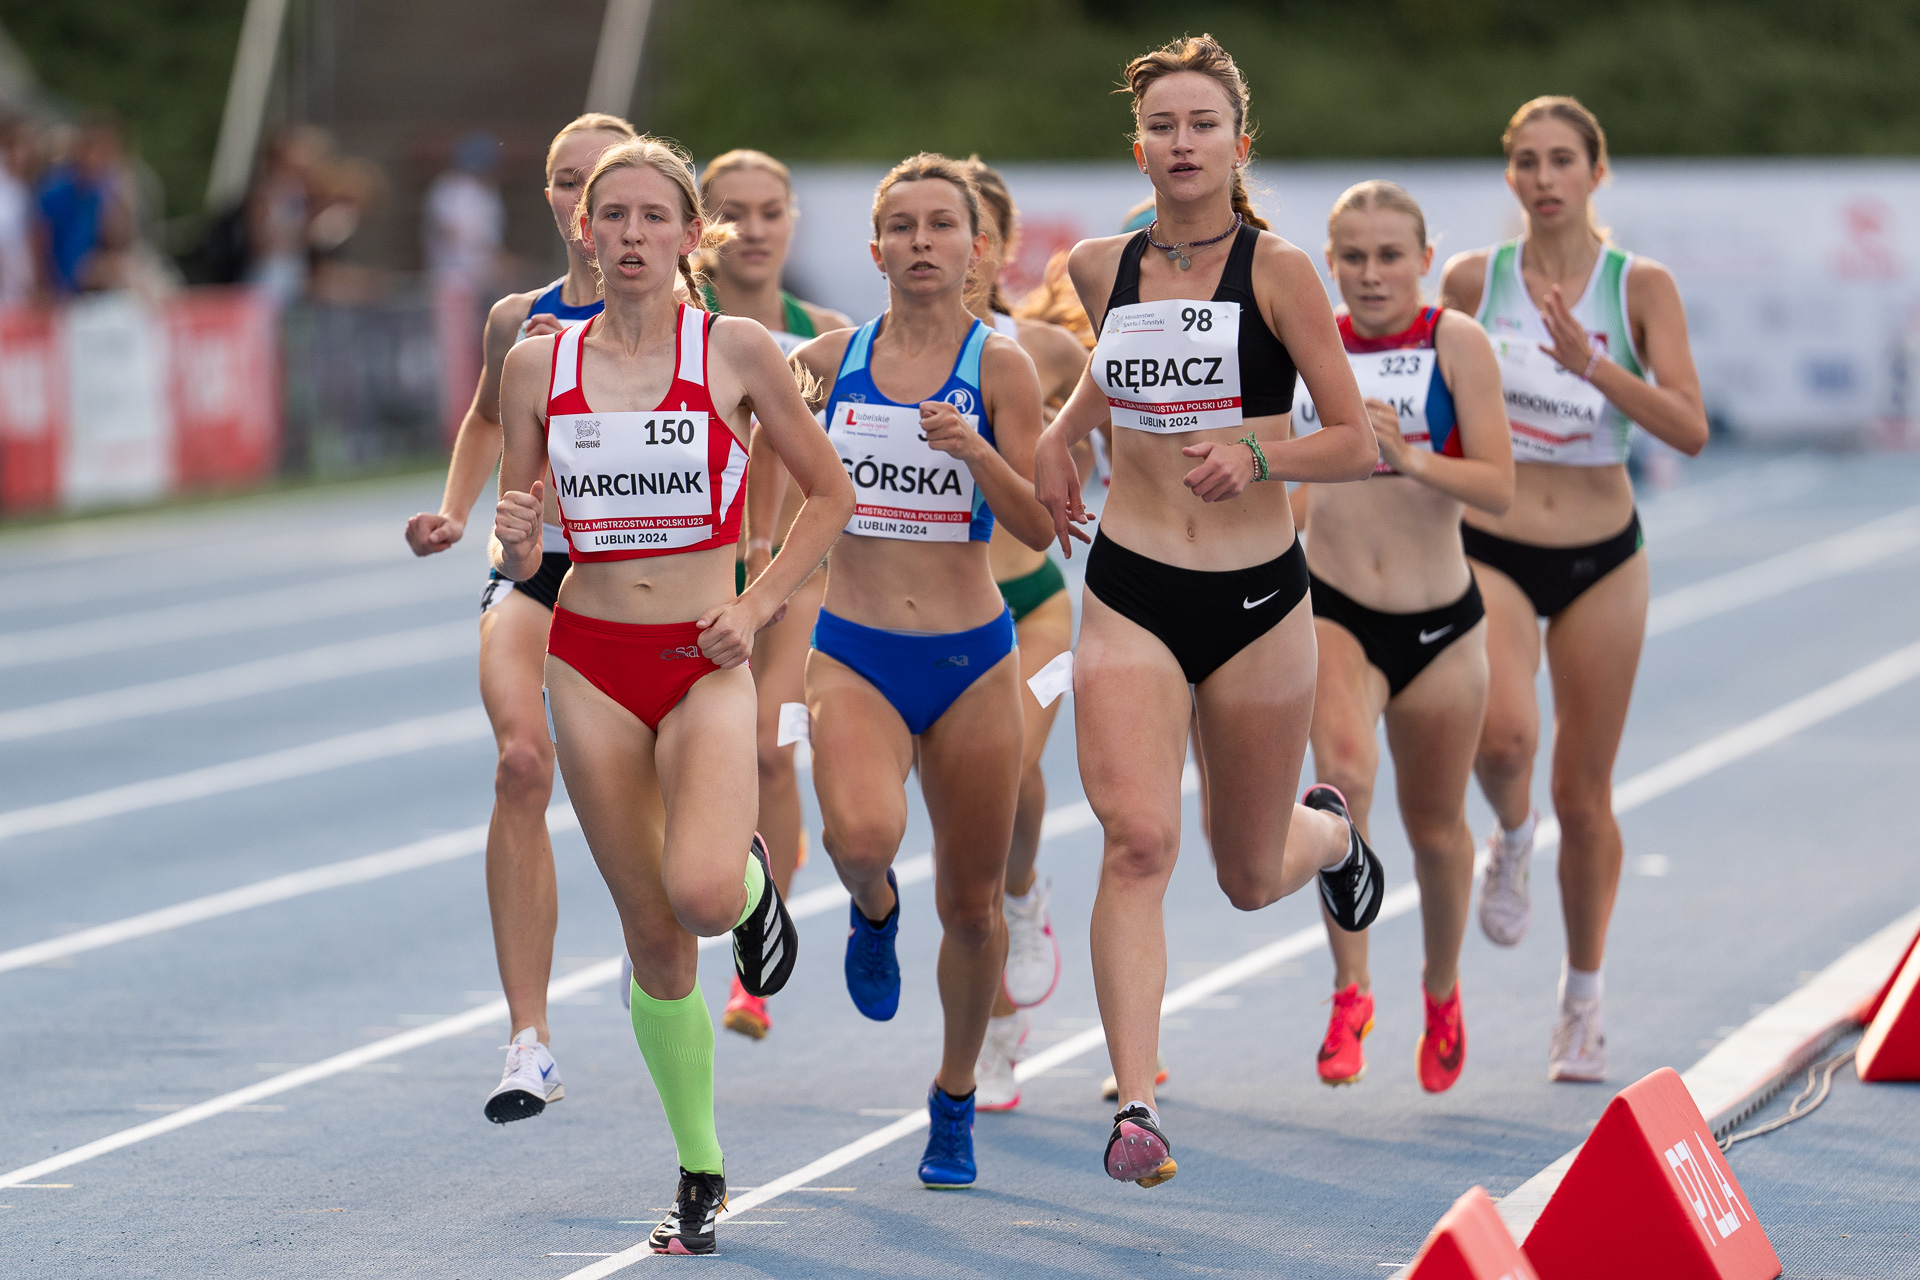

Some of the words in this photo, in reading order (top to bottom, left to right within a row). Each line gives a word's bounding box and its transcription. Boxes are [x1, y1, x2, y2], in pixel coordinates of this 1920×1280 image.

[1142, 318, 1165, 326] Turystyki
[1181, 307, 1212, 332] 98
[1379, 355, 1420, 376] 323
[1106, 356, 1224, 394] RĘBACZ
[1186, 402, 1216, 411] POLSKI
[1217, 399, 1233, 409] U23
[1139, 415, 1167, 428] LUBLIN
[1169, 416, 1198, 427] 2024
[644, 419, 695, 446] 150
[560, 471, 704, 498] MARCINIAK
[858, 506, 916, 520] MISTRZOSTWA
[917, 512, 947, 521] POLSKI
[947, 513, 963, 522] U23
[573, 522, 591, 530] PZLA
[592, 519, 655, 530] MISTRZOSTWA
[656, 518, 686, 528] POLSKI
[686, 517, 704, 526] U23
[858, 520, 897, 533] LUBLIN
[899, 523, 928, 535] 2024
[595, 534, 636, 546] LUBLIN
[638, 533, 668, 543] 2024
[1664, 1130, 1751, 1248] PZLA
